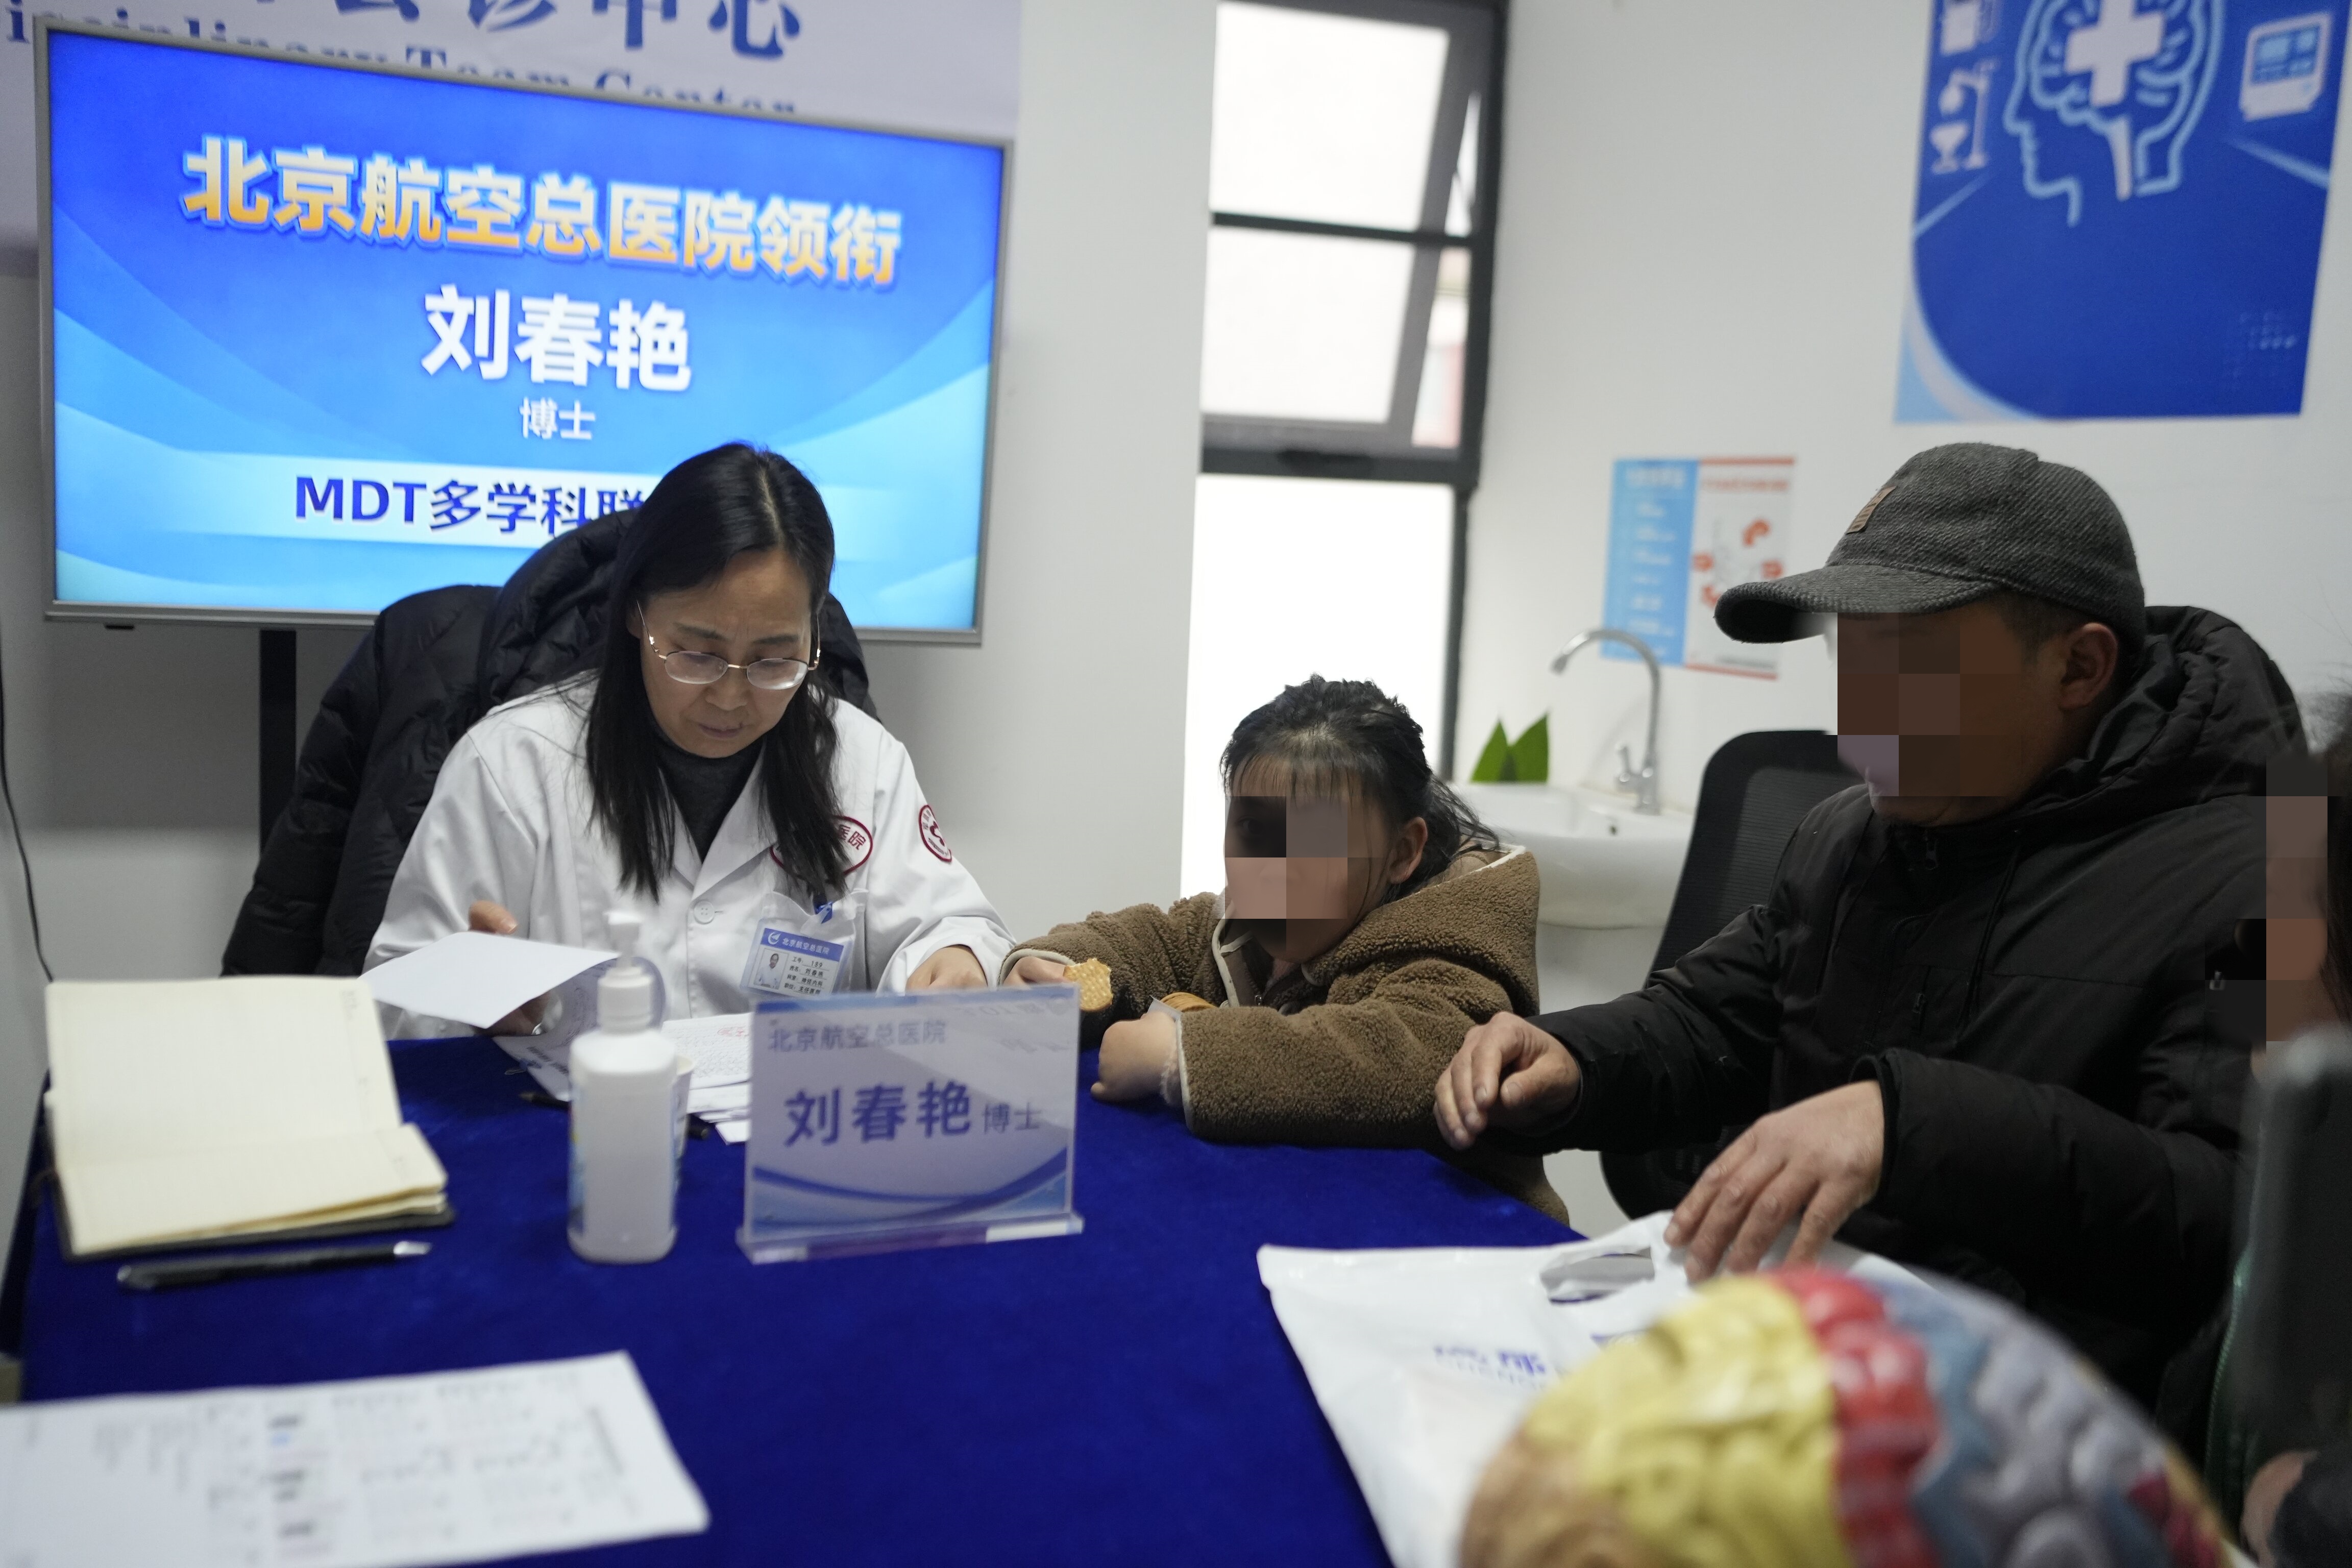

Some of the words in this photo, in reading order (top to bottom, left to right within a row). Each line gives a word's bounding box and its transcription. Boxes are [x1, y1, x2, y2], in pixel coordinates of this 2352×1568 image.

[183, 135, 902, 286] 北京航空总医院领衔
[422, 286, 693, 392] 刘春艳
[519, 400, 596, 443] 博士
[782, 938, 830, 955] 北京航空总医院
[768, 1019, 947, 1053] 北京航空总医院
[784, 1080, 970, 1147] 刘春艳
[982, 1101, 1042, 1134] 博士
